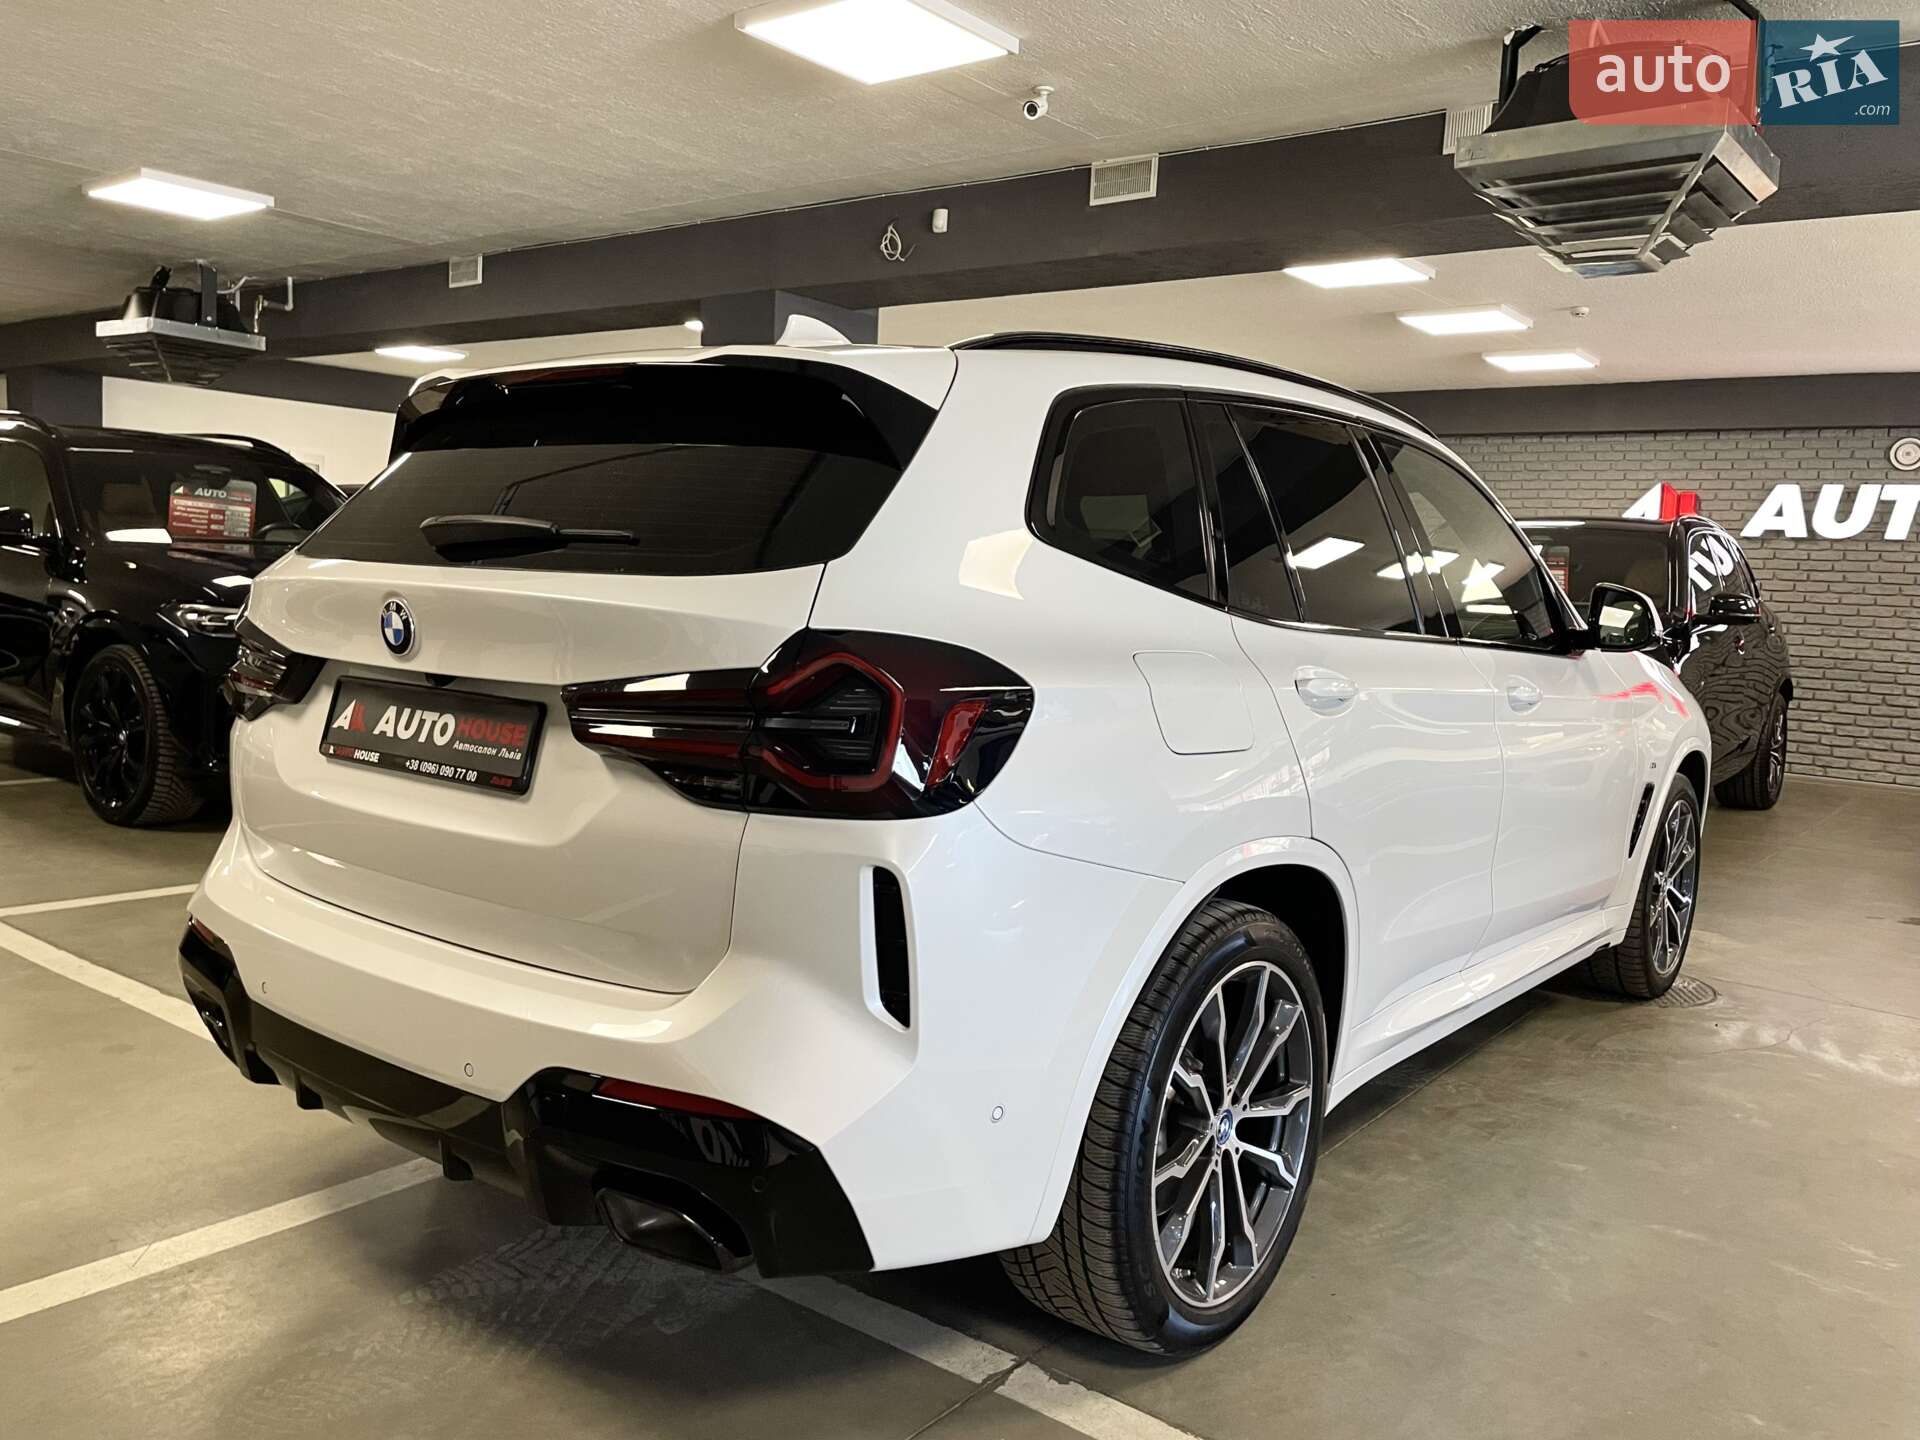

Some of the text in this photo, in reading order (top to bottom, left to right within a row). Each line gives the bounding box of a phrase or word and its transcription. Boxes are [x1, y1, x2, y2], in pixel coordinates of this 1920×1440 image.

[194, 487, 227, 498] AUTO
[373, 705, 456, 747] AUTO
[458, 717, 528, 748] HOUSE
[354, 748, 380, 763] HOUSE
[453, 740, 522, 761] Автосалон Львів
[405, 759, 419, 770] +38
[420, 761, 439, 774] (096)
[440, 765, 454, 777] 090
[455, 768, 466, 779] 77
[466, 771, 477, 782] 00
